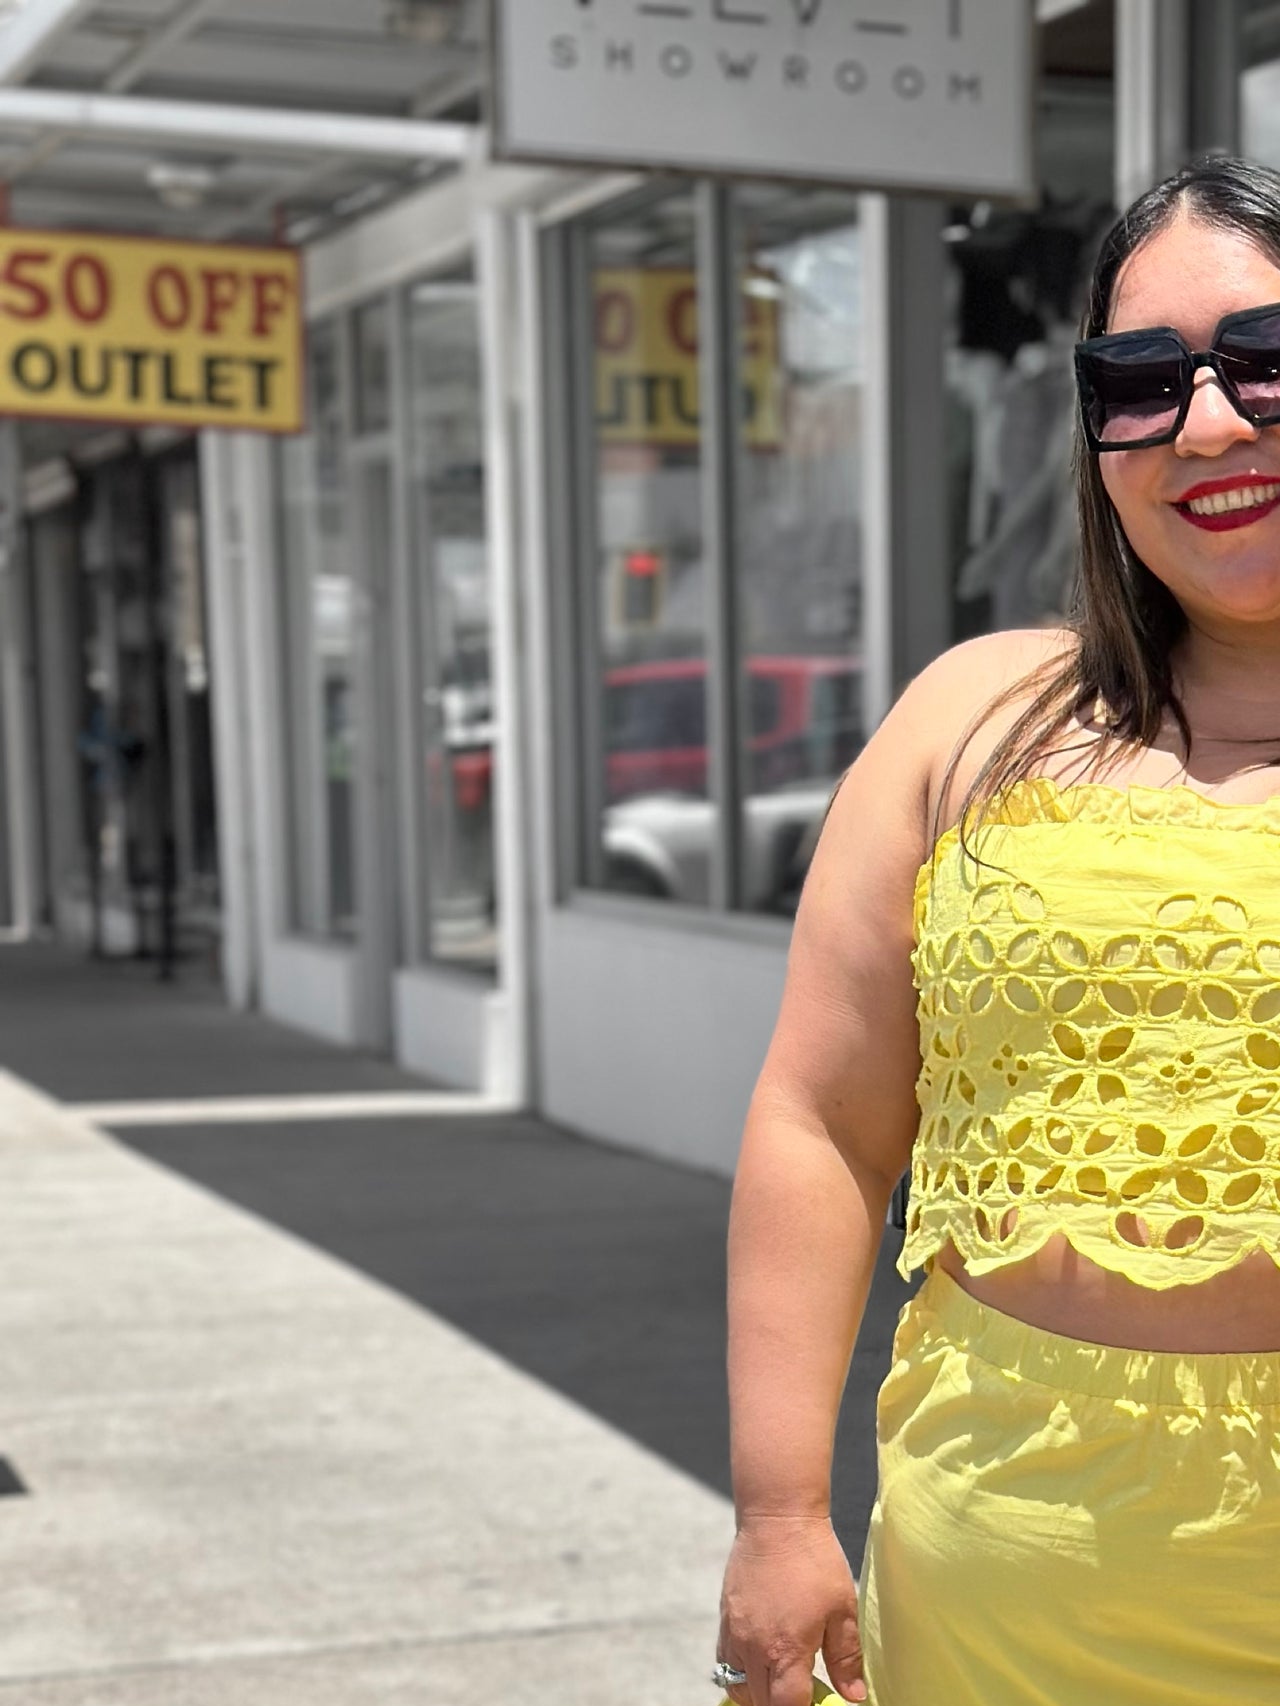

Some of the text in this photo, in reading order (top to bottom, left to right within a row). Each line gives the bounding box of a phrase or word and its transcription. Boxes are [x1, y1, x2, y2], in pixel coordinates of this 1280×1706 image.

[549, 34, 982, 101] SHOWROOM
[0, 251, 290, 337] 50 OFF
[11, 340, 282, 411] OUTLET
